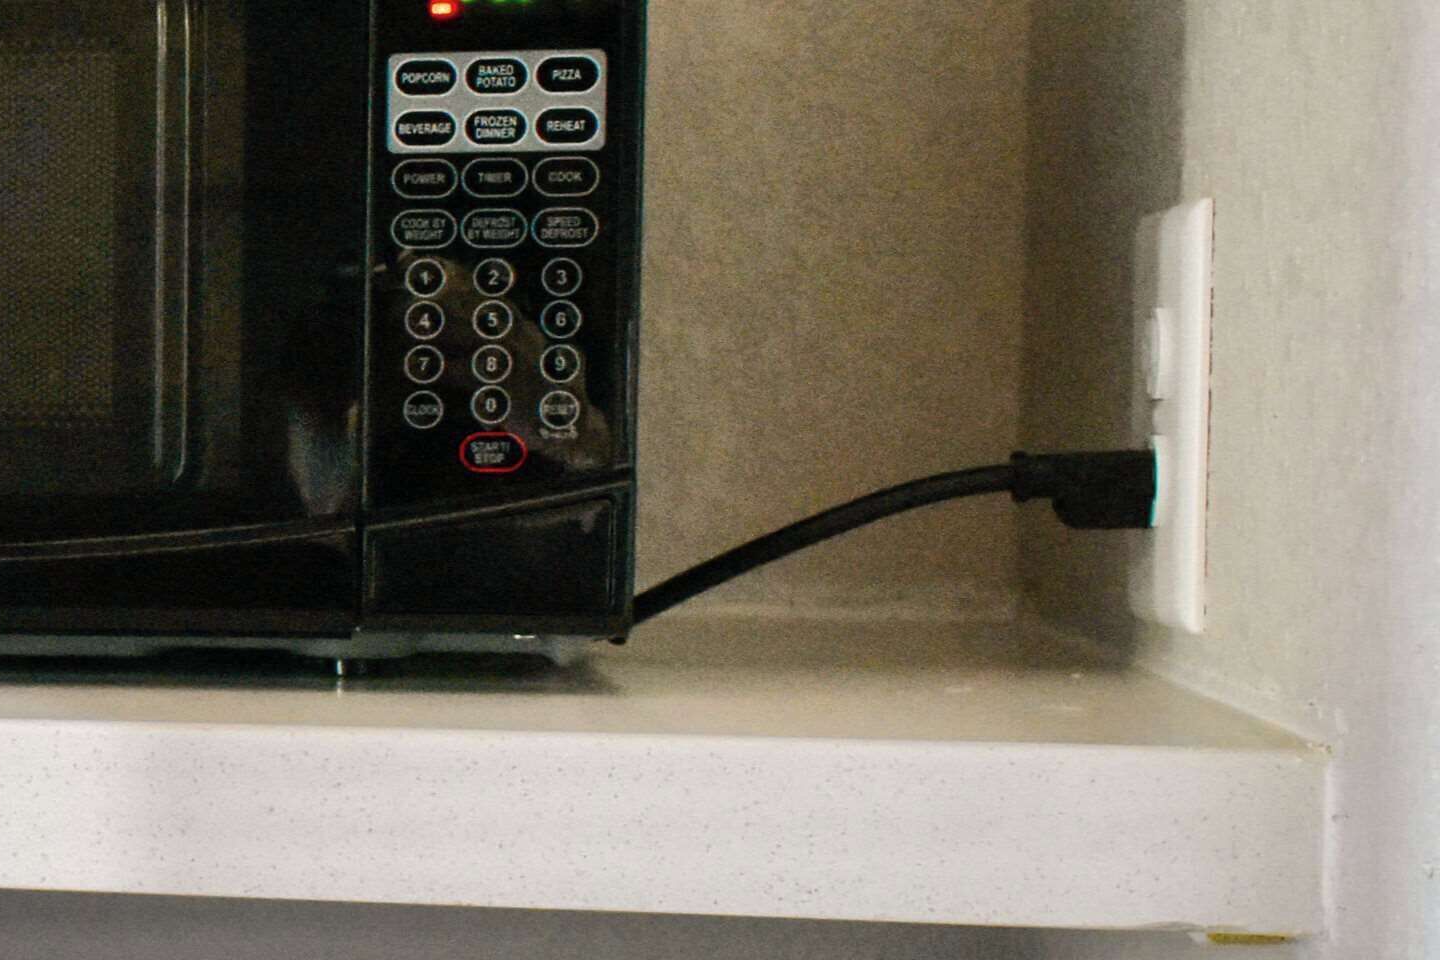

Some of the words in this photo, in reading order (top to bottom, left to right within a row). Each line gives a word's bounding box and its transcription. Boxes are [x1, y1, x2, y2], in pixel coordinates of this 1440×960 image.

[478, 65, 514, 76] BAKED
[552, 69, 581, 81] PIZZA
[401, 72, 450, 84] POPCORN
[476, 76, 517, 88] POTATO
[474, 116, 517, 127] FROZEN
[546, 120, 587, 132] REHEAT
[398, 123, 452, 135] BEVERAGE
[475, 127, 516, 139] DINNER
[403, 173, 446, 184] POWER
[478, 172, 512, 184] TIMER
[548, 171, 582, 183] COOK
[401, 218, 429, 229] COOK
[471, 217, 515, 228] DEFROST
[547, 216, 581, 227] SPEED
[541, 227, 589, 239] DEFROST
[419, 271, 430, 285] 1
[488, 270, 500, 285] 2
[556, 270, 568, 285] 3
[418, 313, 431, 328] 4
[487, 312, 498, 327] 5
[555, 312, 567, 326] 6
[418, 357, 429, 371] 7
[486, 356, 497, 372] 8
[555, 356, 566, 371] 9
[485, 398, 496, 413] 0
[474, 453, 505, 464] STOP
